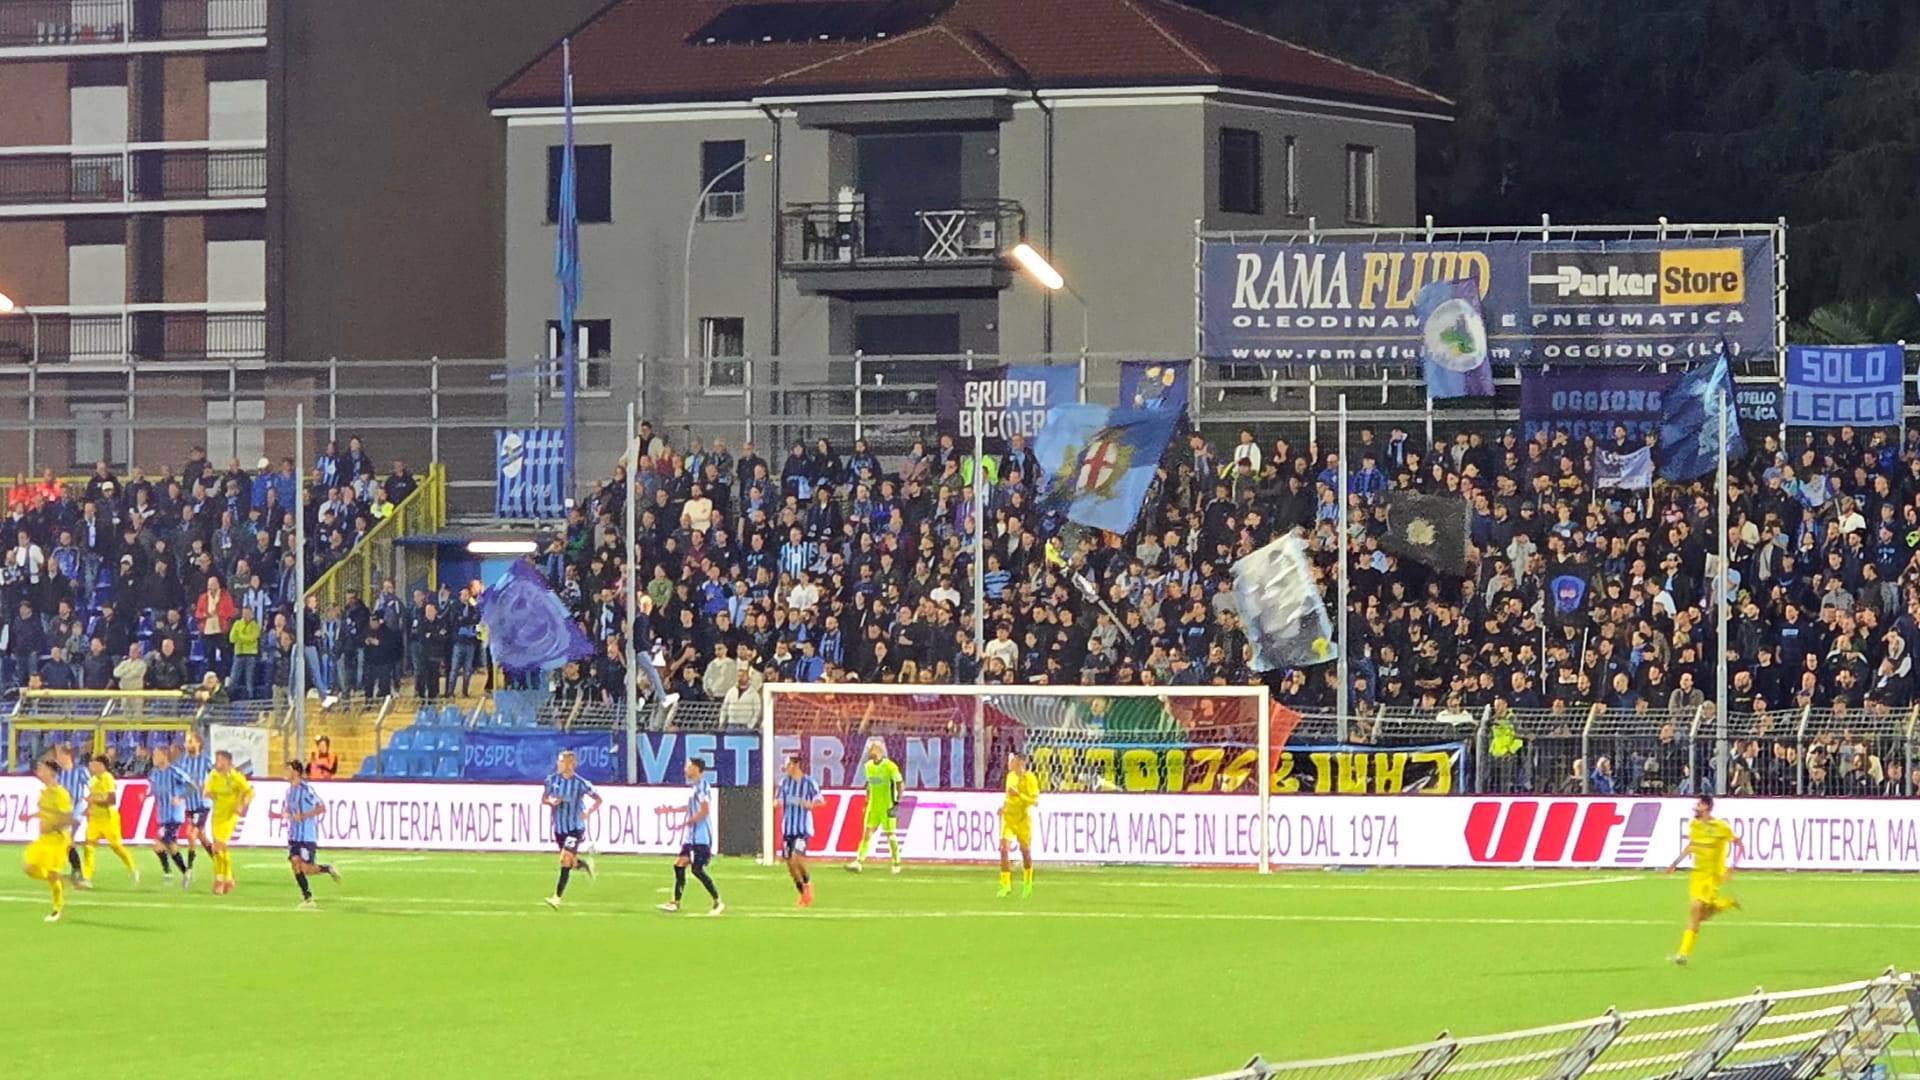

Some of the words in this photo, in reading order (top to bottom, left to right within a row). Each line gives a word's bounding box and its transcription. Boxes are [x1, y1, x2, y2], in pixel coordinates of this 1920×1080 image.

[1231, 251, 1352, 310] RAMA
[1556, 265, 1657, 297] Parker
[1664, 267, 1738, 294] Store
[1232, 315, 1421, 328] OLEODINAM
[1532, 310, 1745, 328] PNEUMATICA
[1543, 343, 1676, 359] OGGIONO
[1801, 350, 1886, 383] SOLO
[965, 380, 1047, 408] GRUPPO
[1792, 391, 1895, 421] LECCO
[366, 801, 443, 842] VITERIA
[449, 802, 504, 843] MADE
[510, 803, 531, 843] IN
[608, 805, 646, 846] DAL
[1039, 812, 1122, 854] VITERIA
[1128, 813, 1186, 855] MADE
[1194, 814, 1216, 856] IN
[1225, 814, 1292, 858] LECCO
[1300, 815, 1340, 858] DAL
[1350, 815, 1399, 859] 1974
[1793, 818, 1880, 862] VITERIA
